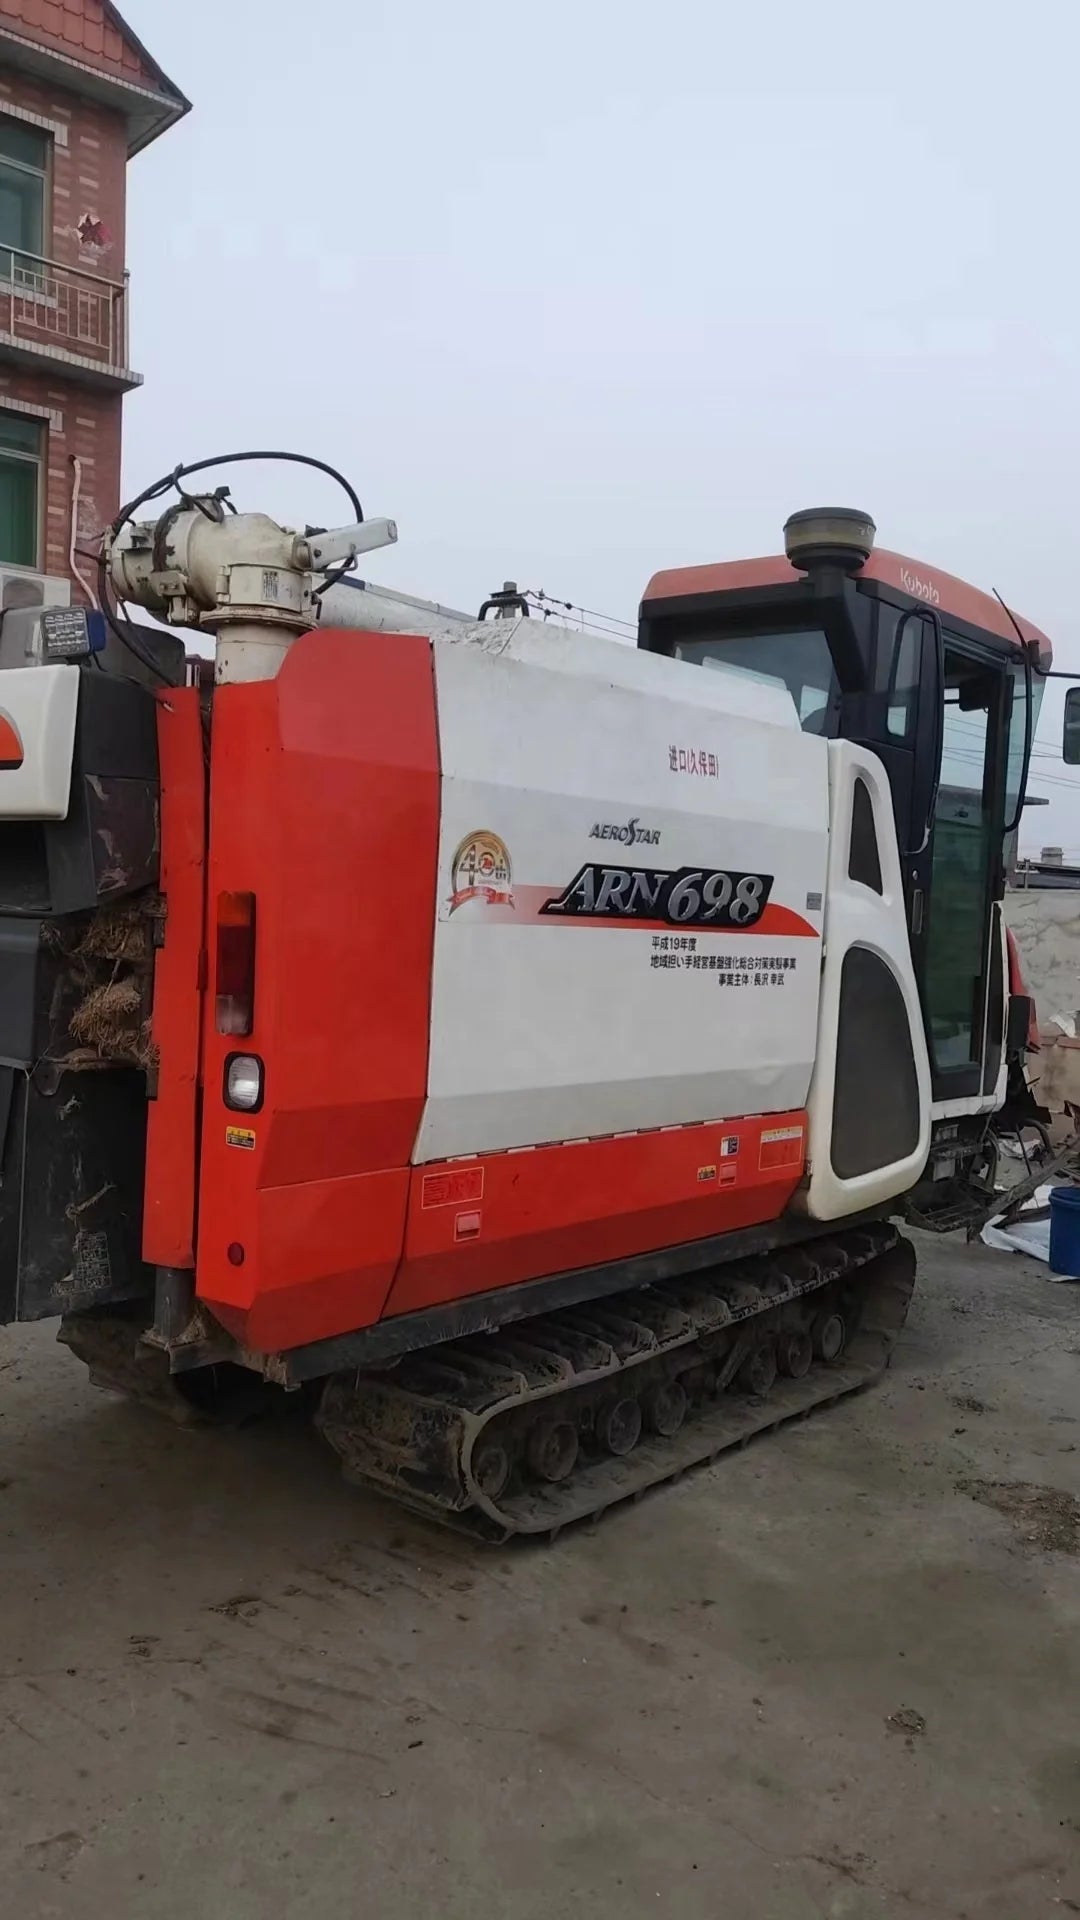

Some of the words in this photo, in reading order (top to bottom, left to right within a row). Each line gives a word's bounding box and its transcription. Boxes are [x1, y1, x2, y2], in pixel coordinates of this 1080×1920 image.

[900, 567, 940, 604] Kubota
[588, 817, 661, 846] AEROSTAR
[651, 935, 697, 952] 平成19年度
